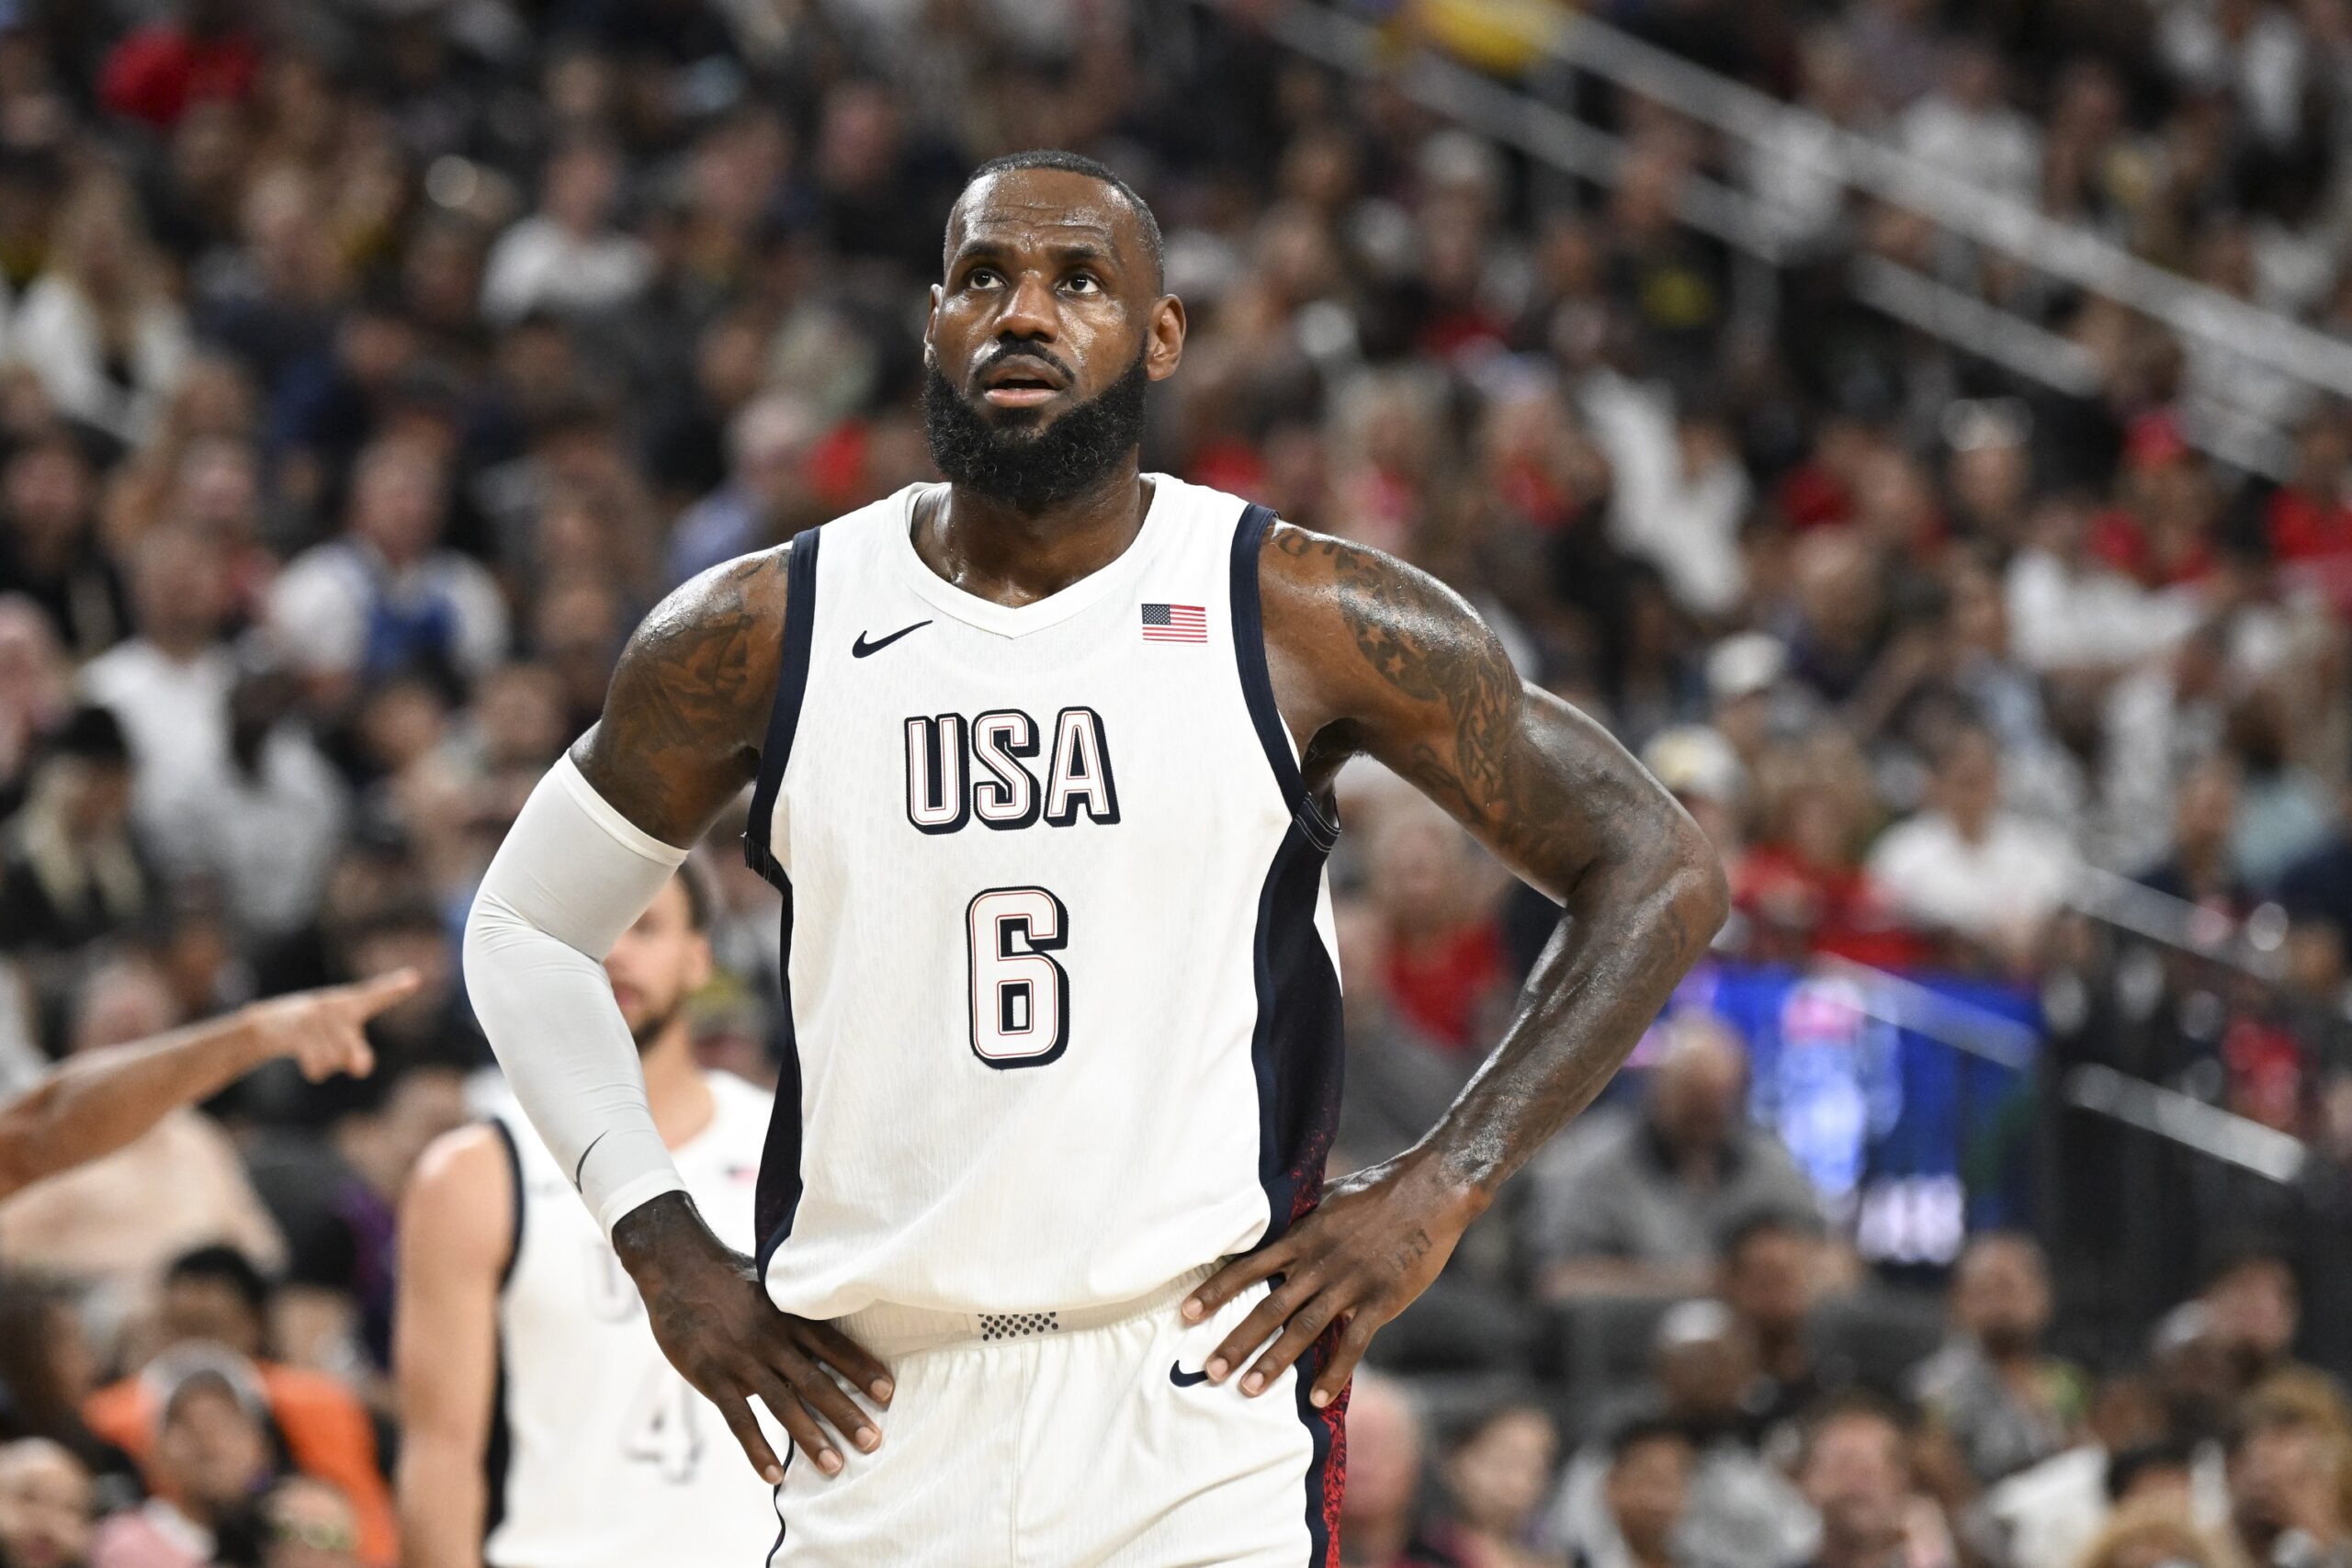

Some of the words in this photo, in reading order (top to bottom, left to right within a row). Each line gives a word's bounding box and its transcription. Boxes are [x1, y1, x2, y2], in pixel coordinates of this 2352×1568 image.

[904, 706, 1121, 835] USA
[966, 886, 1069, 1071] 6
[617, 1358, 705, 1485] 4
